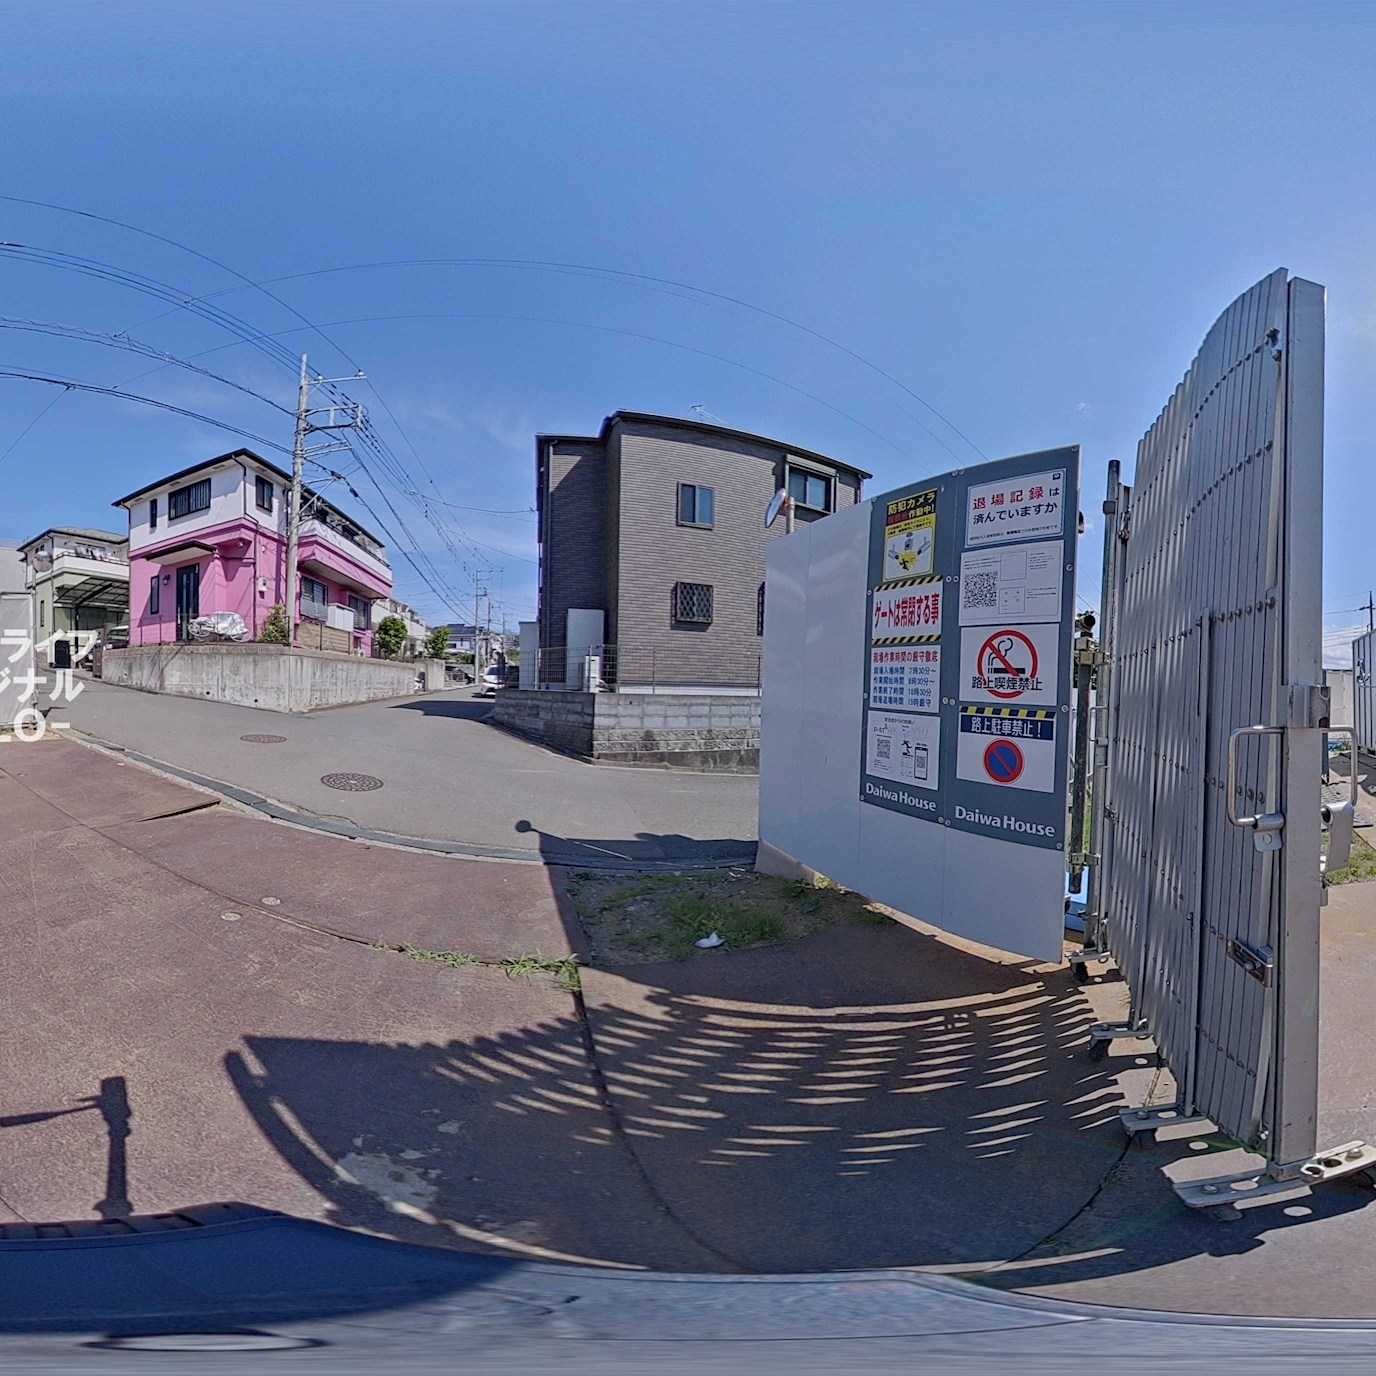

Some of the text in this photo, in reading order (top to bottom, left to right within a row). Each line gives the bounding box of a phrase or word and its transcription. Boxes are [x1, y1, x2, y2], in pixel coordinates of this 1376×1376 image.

[888, 492, 935, 515] 防犯カメラ
[972, 486, 1060, 510] 退場記録は
[973, 502, 1057, 525] 済んでいますか
[972, 676, 1043, 691] 路上喫煙禁止
[865, 783, 937, 812] Daiwa House
[955, 806, 1055, 838] Daiwa House
